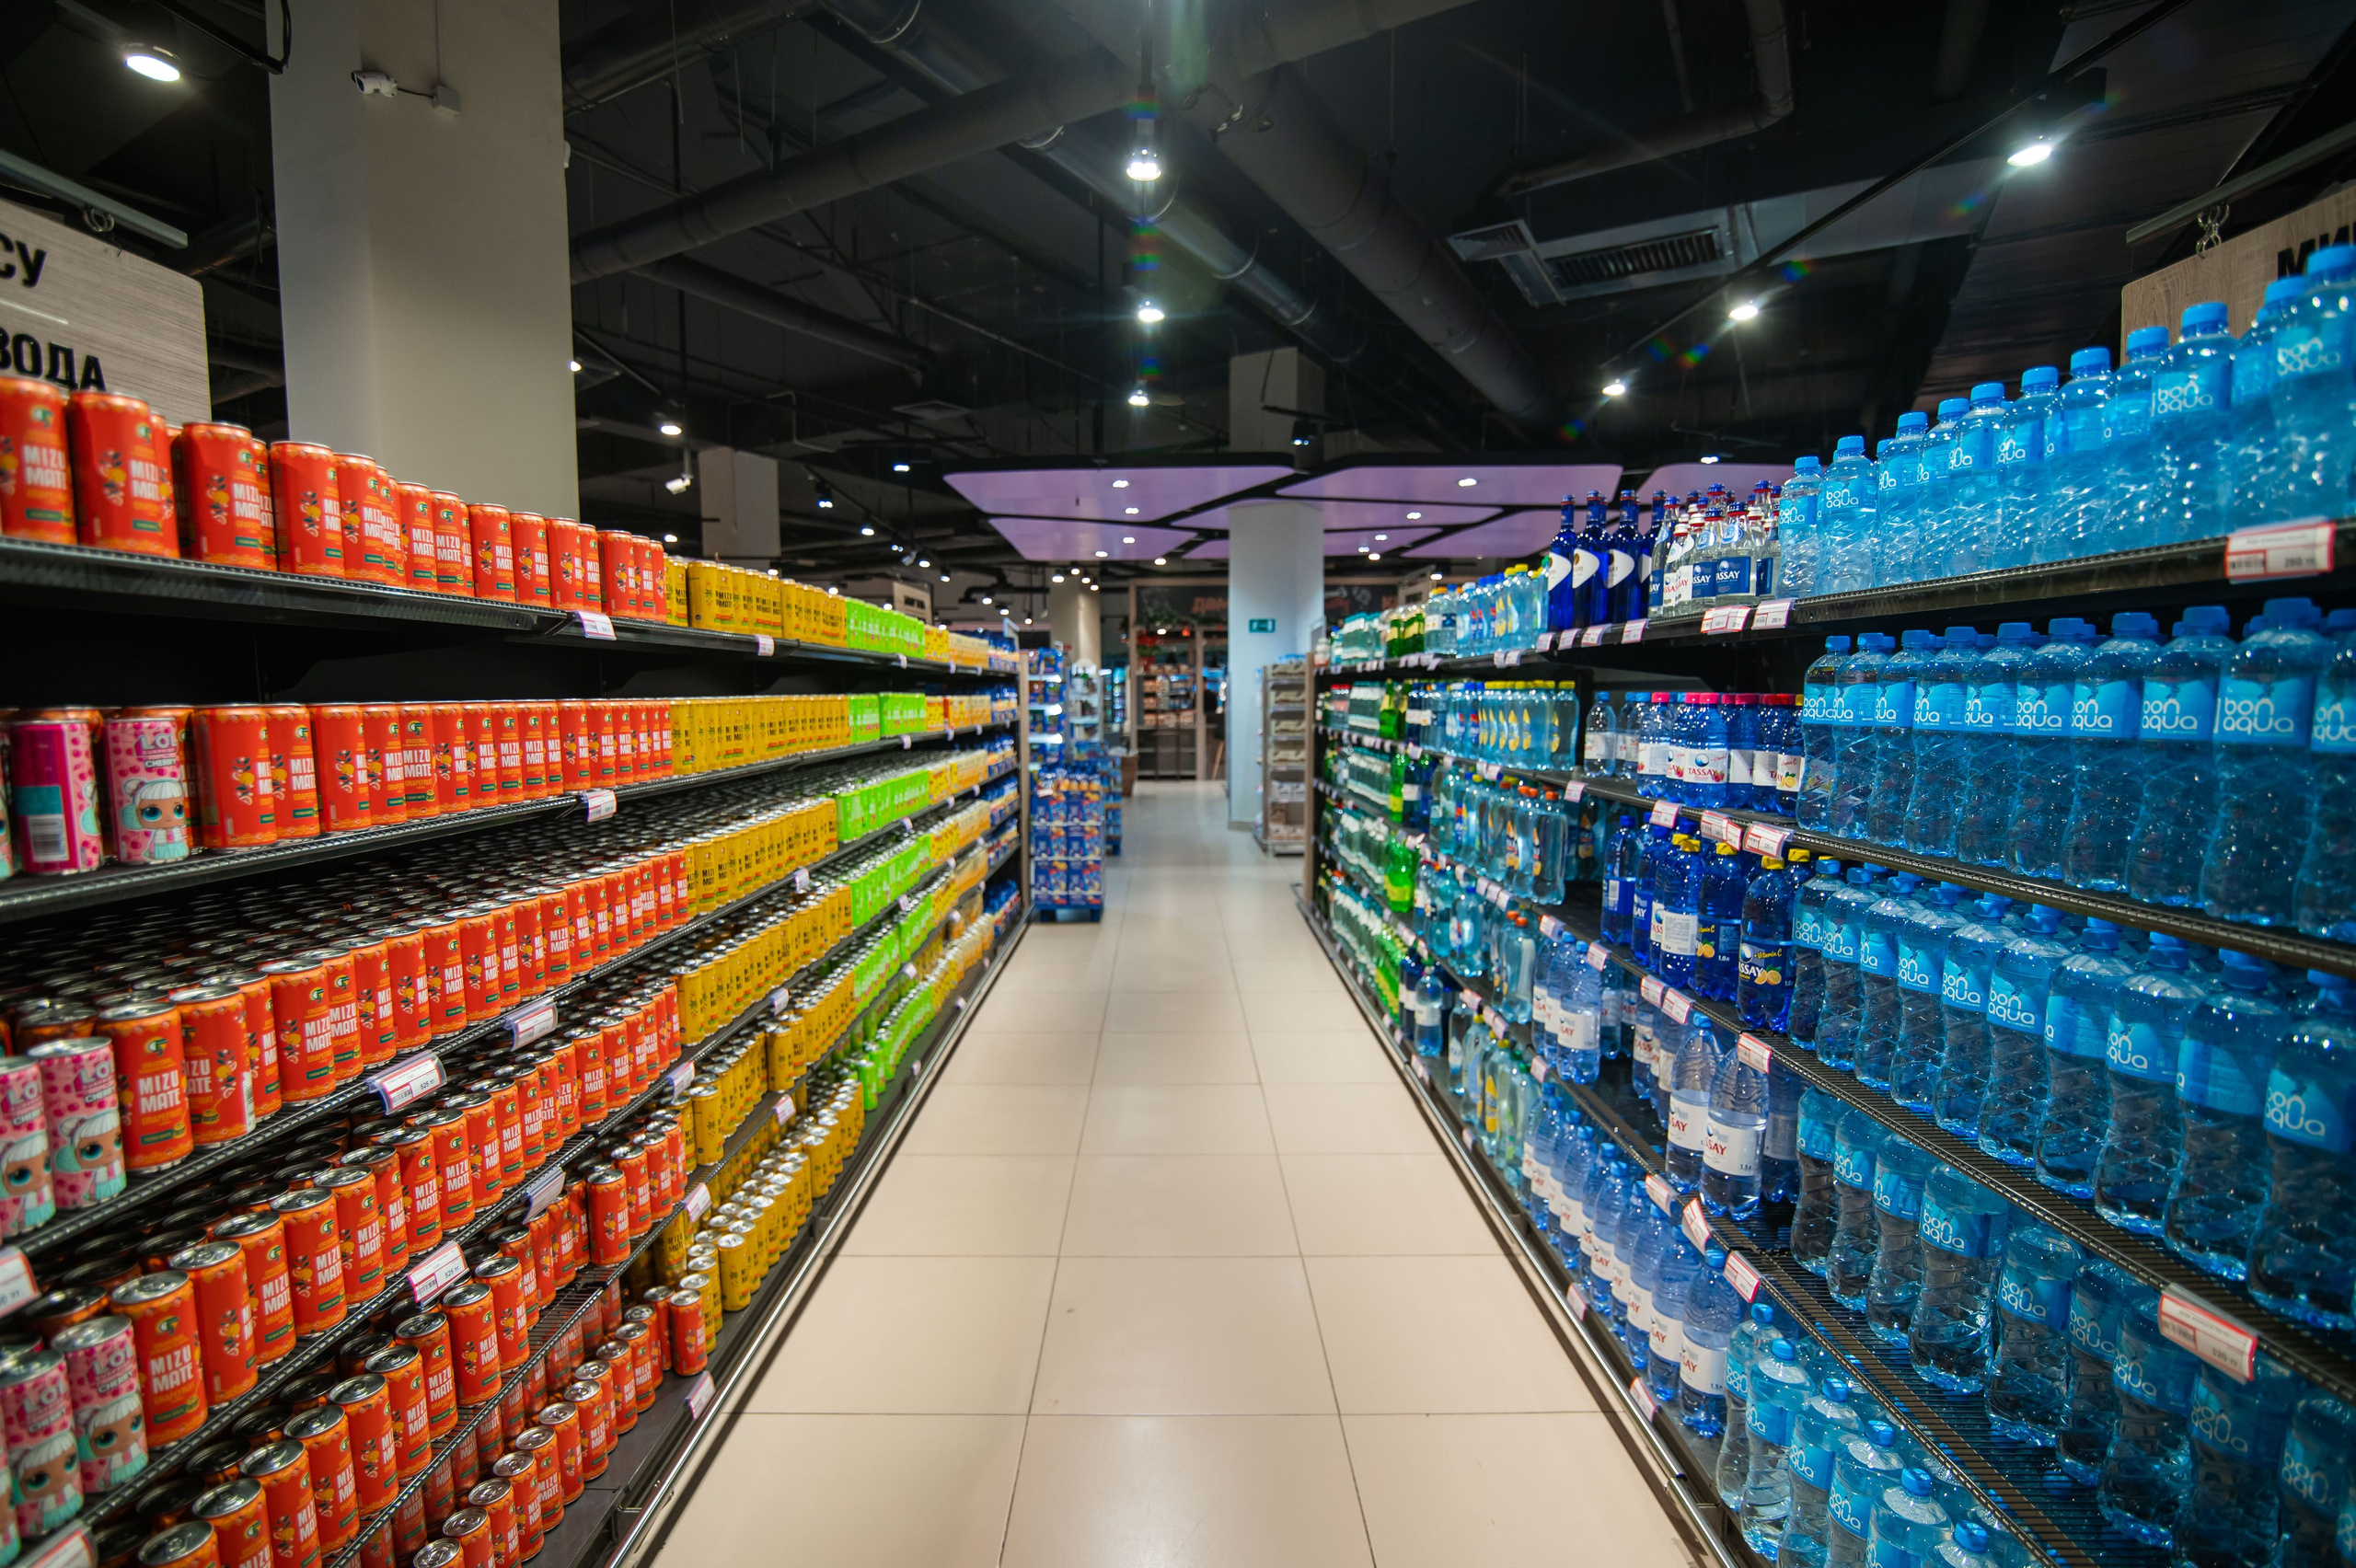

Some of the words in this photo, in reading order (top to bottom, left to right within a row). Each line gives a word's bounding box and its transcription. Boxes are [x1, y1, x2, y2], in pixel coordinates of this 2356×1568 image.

[2158, 380, 2199, 402] bon
[2158, 394, 2212, 414] aqua
[1826, 489, 1850, 499] bon
[1826, 495, 1859, 509] aqua
[436, 536, 460, 550] MIZU
[437, 549, 462, 562] MATE
[1716, 571, 1739, 581] ASSAY
[1966, 699, 1981, 711] on
[2224, 698, 2274, 716] bon
[1965, 710, 1992, 724] qua
[2016, 712, 2062, 729] aqua
[2223, 715, 2294, 735] aqua
[403, 749, 431, 764] MIZU
[404, 764, 432, 778] MATE
[1688, 767, 1717, 776] TASSAY
[1990, 986, 2021, 1007] bon
[329, 1003, 356, 1022] MIZU
[1988, 1001, 2035, 1025] aqua
[330, 1019, 358, 1038] MATE
[139, 1070, 179, 1094] MIZU
[421, 1081, 430, 1090] 525
[141, 1090, 181, 1114] MATE
[1923, 1210, 1953, 1234] bon
[1923, 1224, 1964, 1249] aqua
[445, 1270, 455, 1278] 525
[2002, 1276, 2033, 1301] bon
[2001, 1291, 2046, 1317] aqua
[151, 1345, 191, 1376] MIZU
[152, 1363, 194, 1394] MATE
[429, 1365, 452, 1385] MIZU
[430, 1379, 453, 1397] MATE
[538, 1472, 559, 1488] MIZU
[539, 1486, 560, 1504] MATE
[1830, 1499, 1861, 1530] aqua
